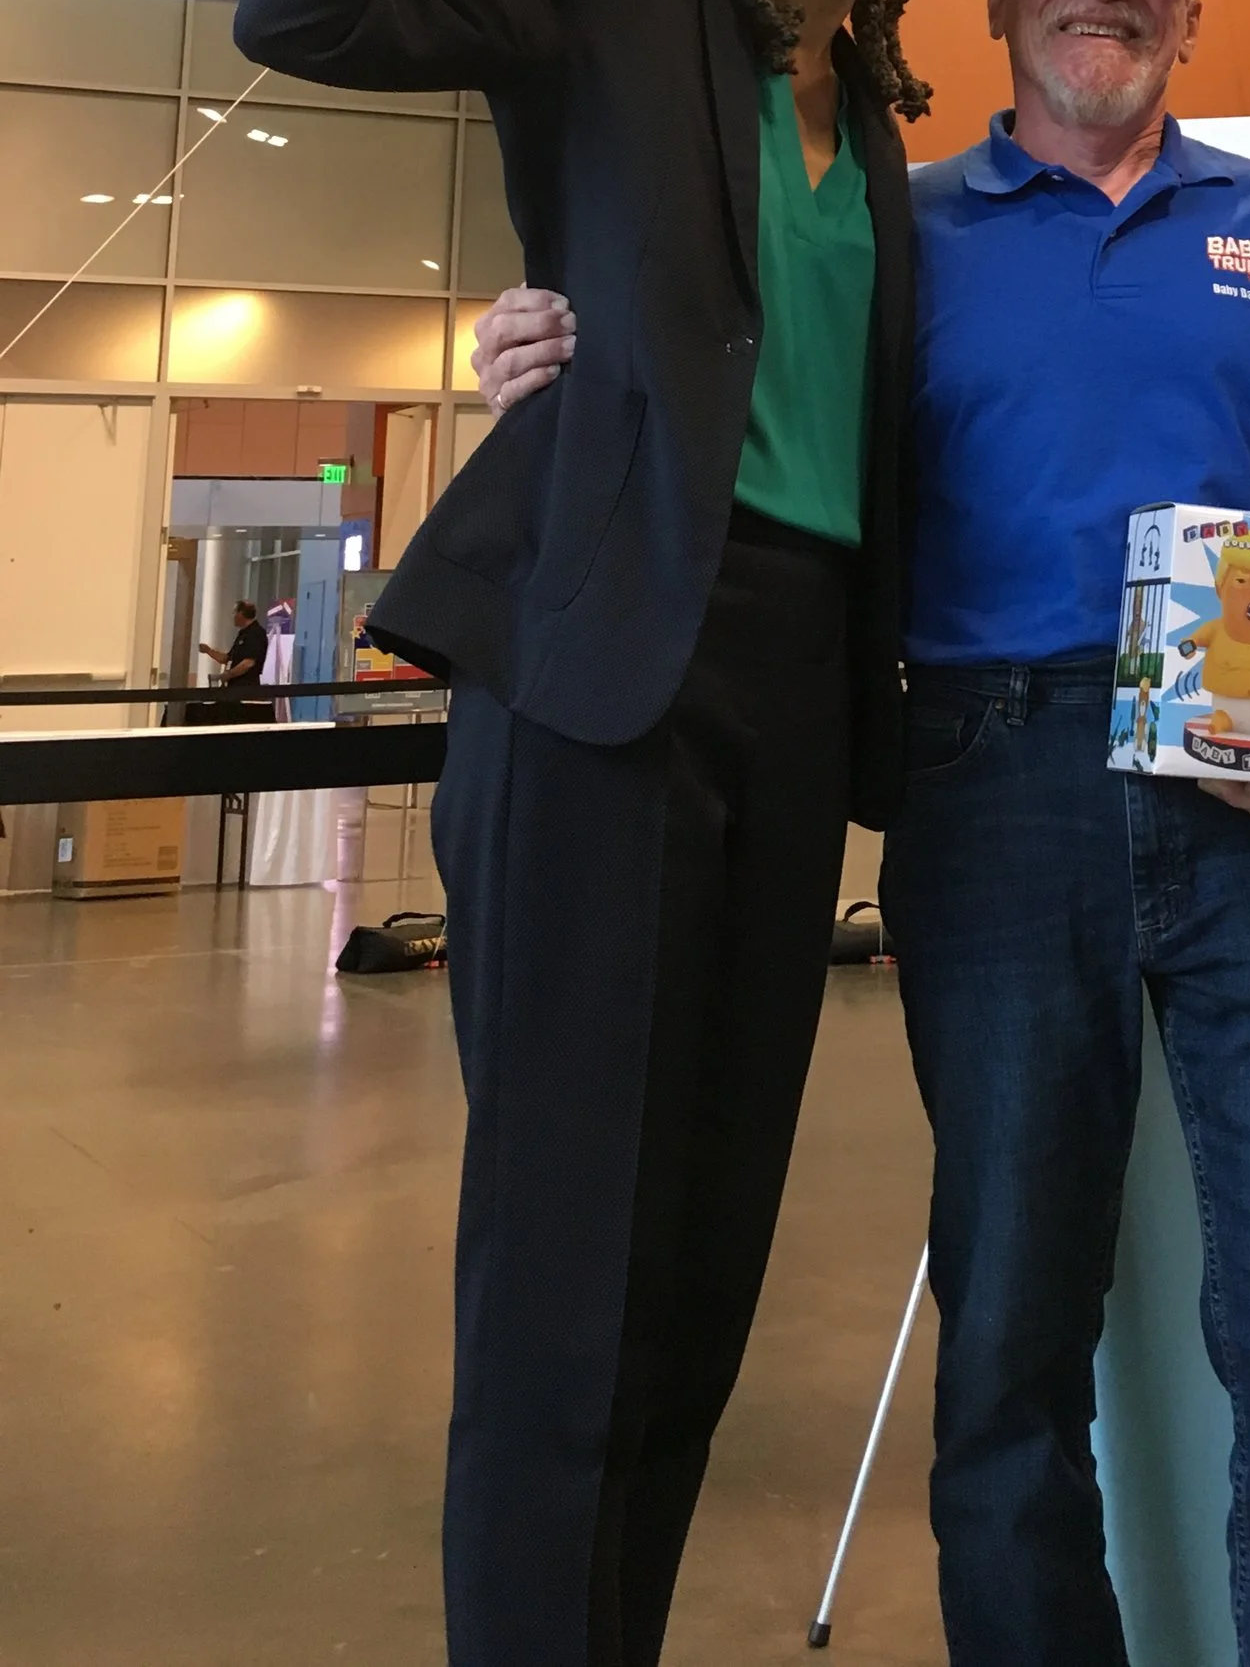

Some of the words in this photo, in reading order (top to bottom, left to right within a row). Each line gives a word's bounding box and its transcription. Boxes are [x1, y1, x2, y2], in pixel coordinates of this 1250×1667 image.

[1212, 283, 1239, 297] Baby
[1183, 520, 1249, 543] BABY
[1191, 736, 1236, 764] BABY
